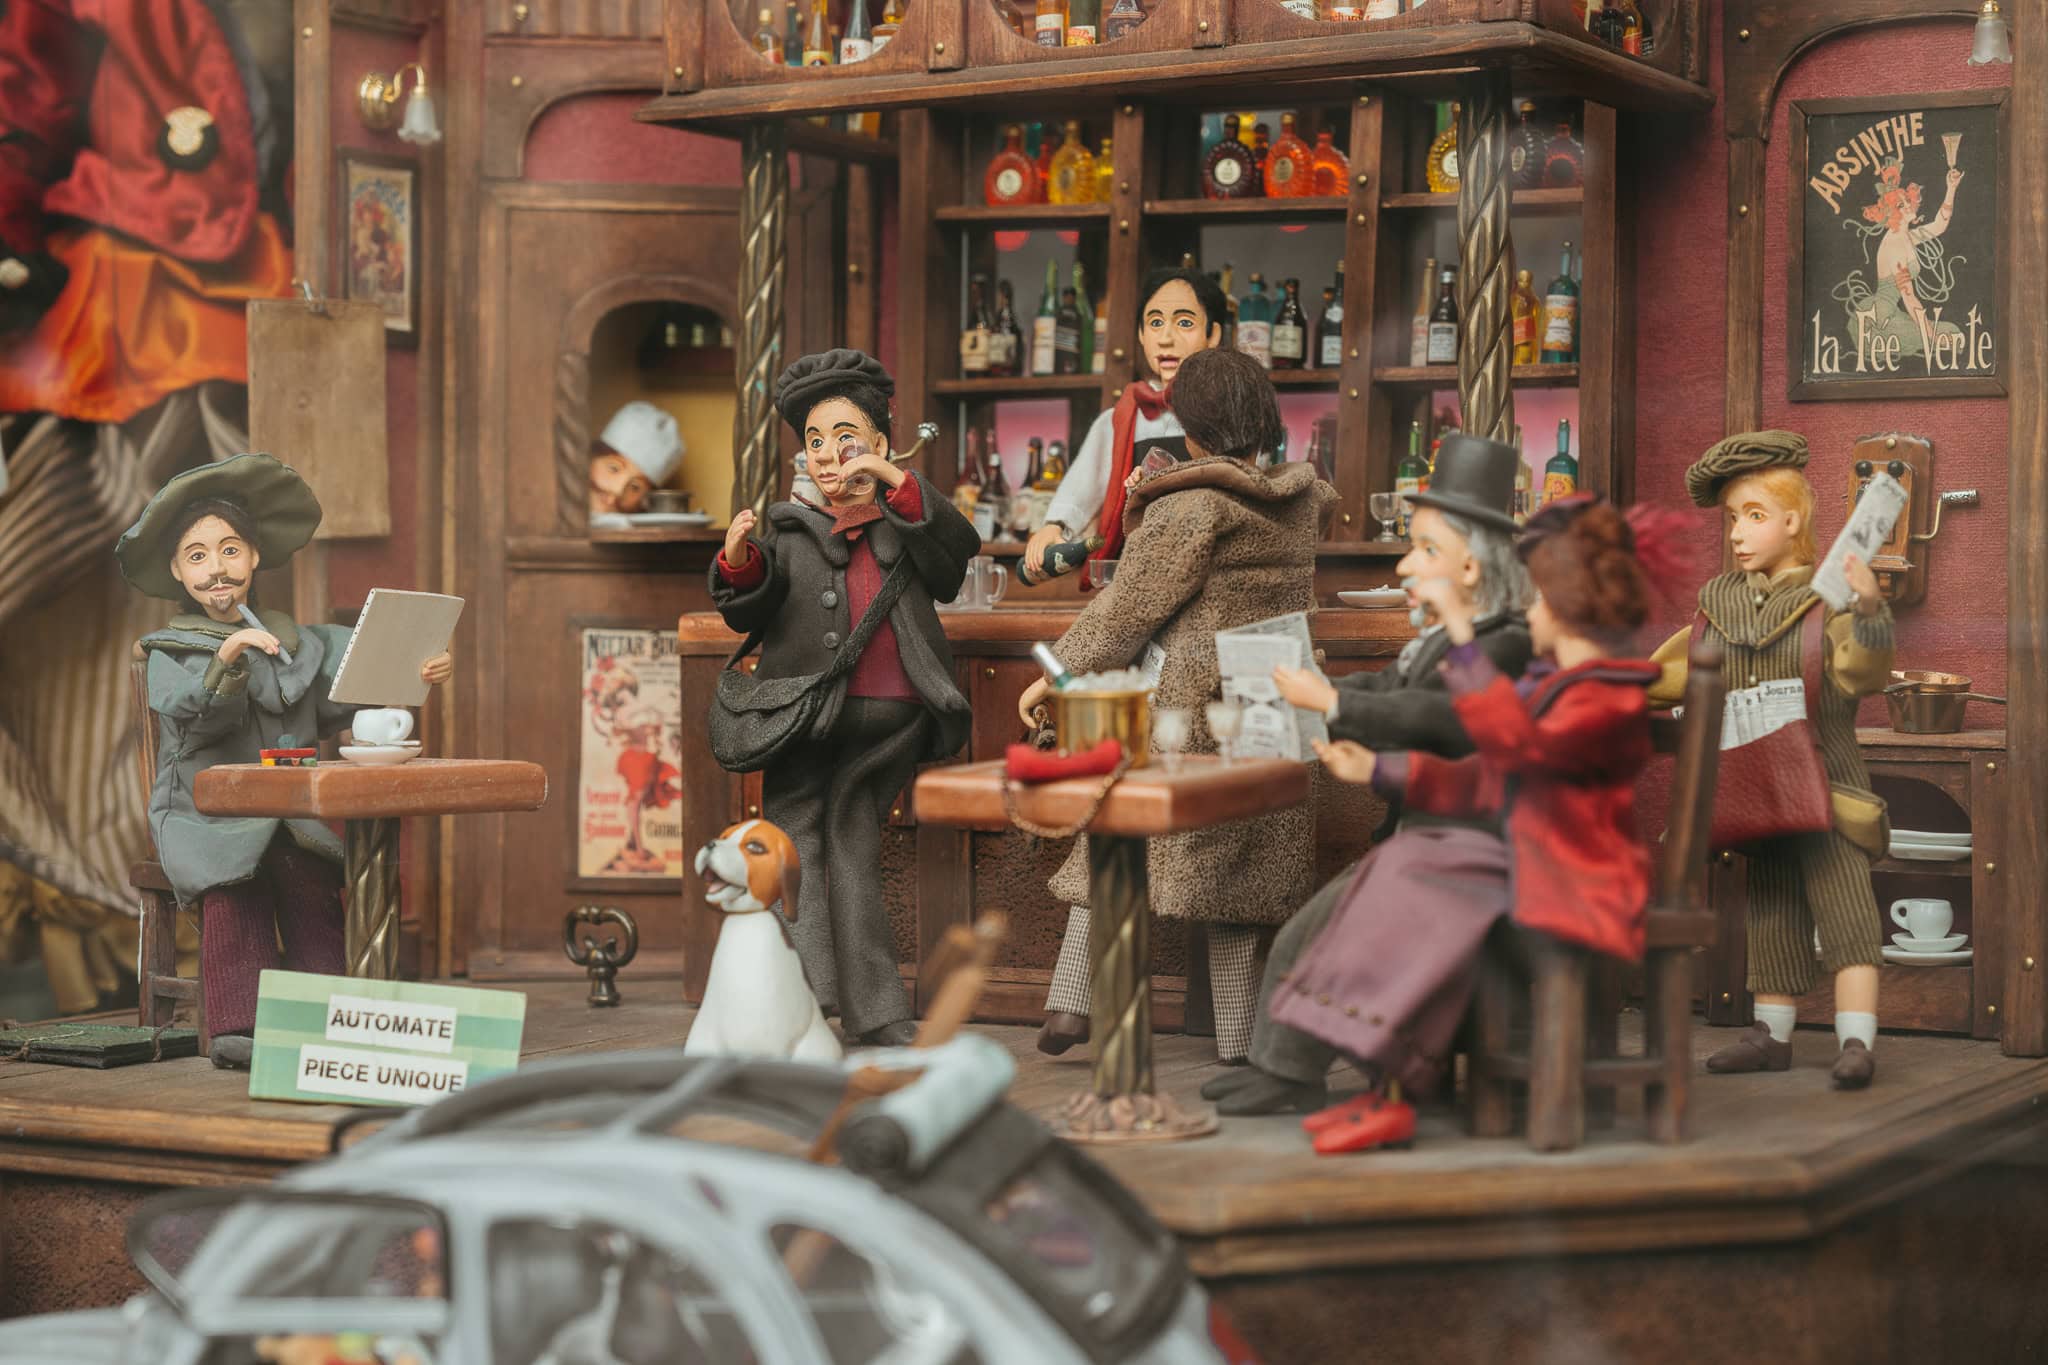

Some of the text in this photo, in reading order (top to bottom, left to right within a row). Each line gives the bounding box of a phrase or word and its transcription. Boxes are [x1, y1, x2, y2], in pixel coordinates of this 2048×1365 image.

[1809, 112, 1924, 215] ABSINTHE
[1812, 303, 1993, 376] la Fée Verte
[330, 1008, 453, 1040] AUTOMATE
[304, 1058, 463, 1093] PIECE UNIQUE
